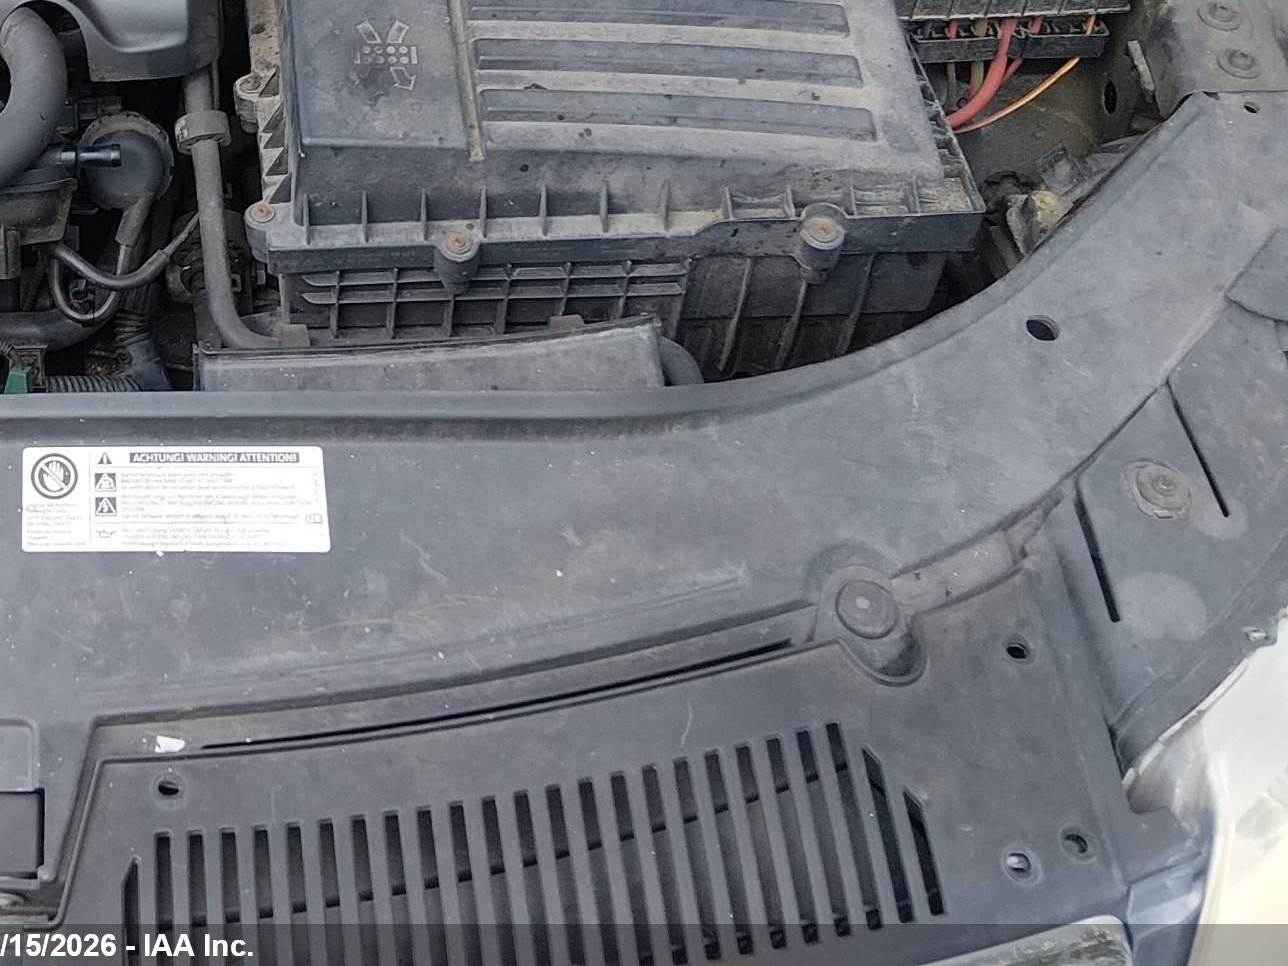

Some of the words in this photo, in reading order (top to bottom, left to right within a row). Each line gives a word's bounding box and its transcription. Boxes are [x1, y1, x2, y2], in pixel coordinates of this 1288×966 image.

[132, 453, 185, 463] ACHTUNG!
[187, 452, 237, 463] WARNING!
[239, 452, 297, 463] ATTENTION!
